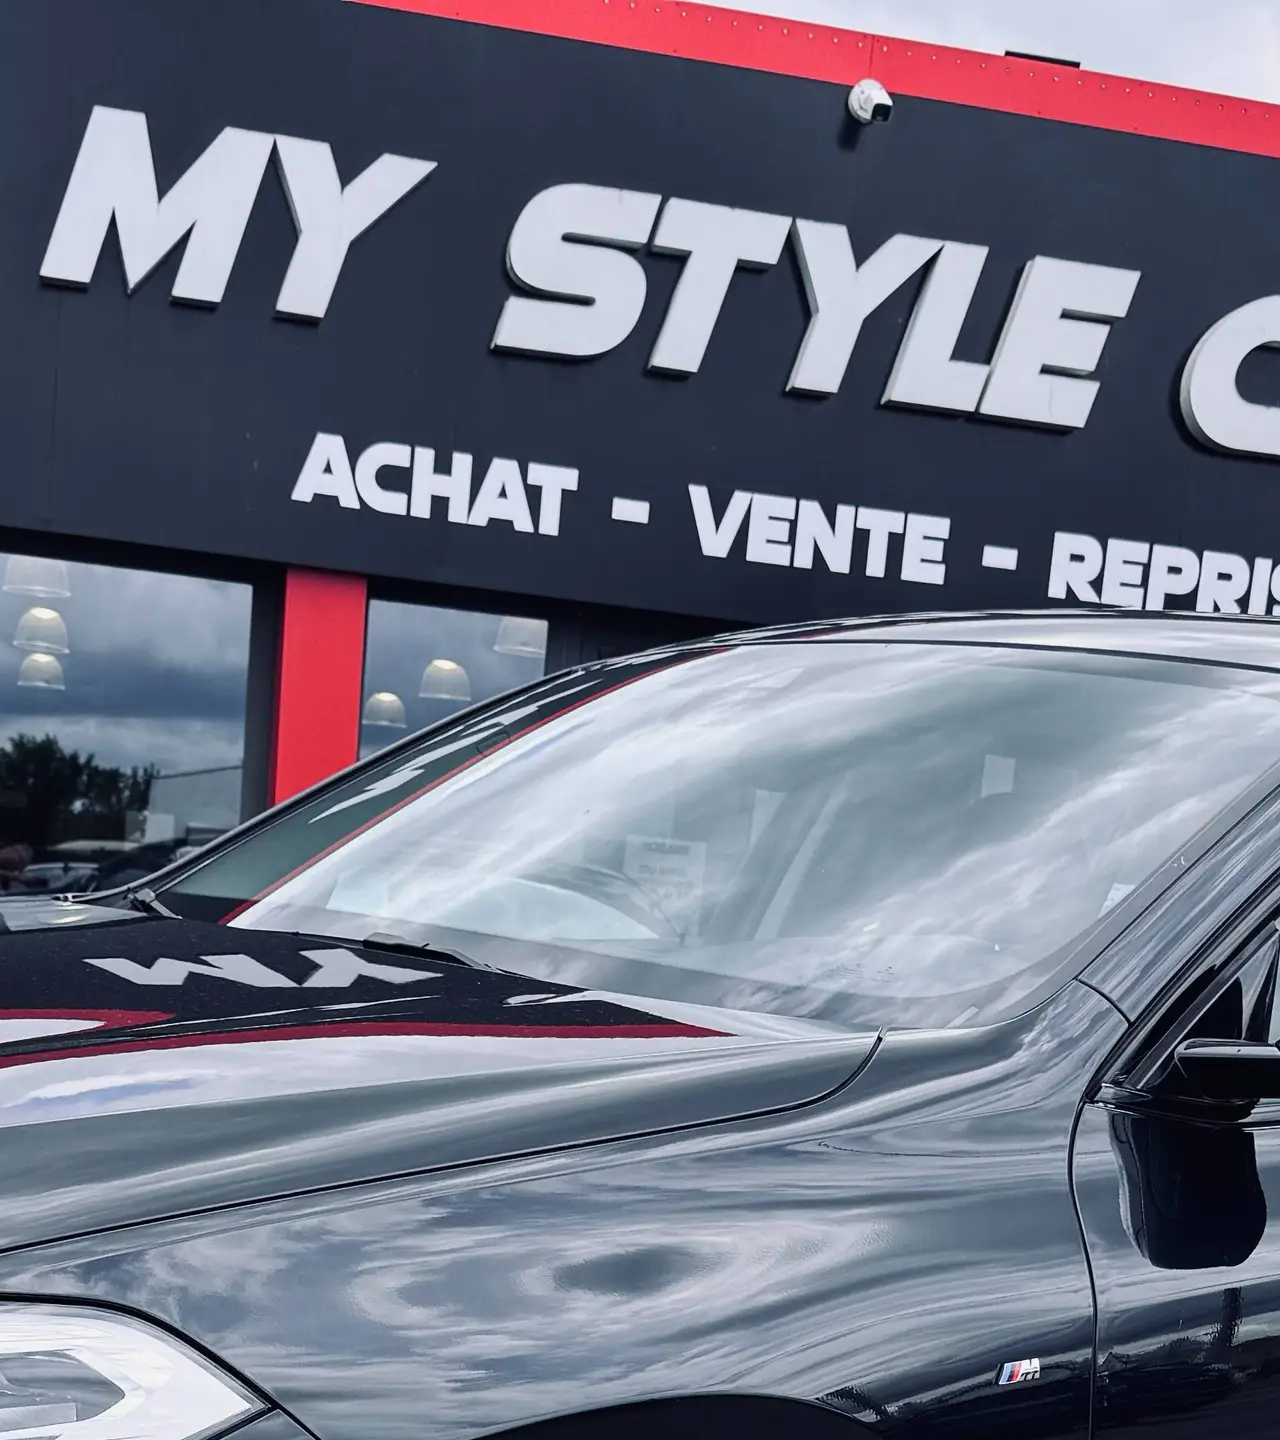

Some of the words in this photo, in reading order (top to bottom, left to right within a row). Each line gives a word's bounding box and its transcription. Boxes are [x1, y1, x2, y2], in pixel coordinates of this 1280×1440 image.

[39, 105, 438, 321] MY
[490, 183, 1142, 430] STYLE
[291, 432, 579, 536] ACHAT
[687, 483, 951, 585] VENTE
